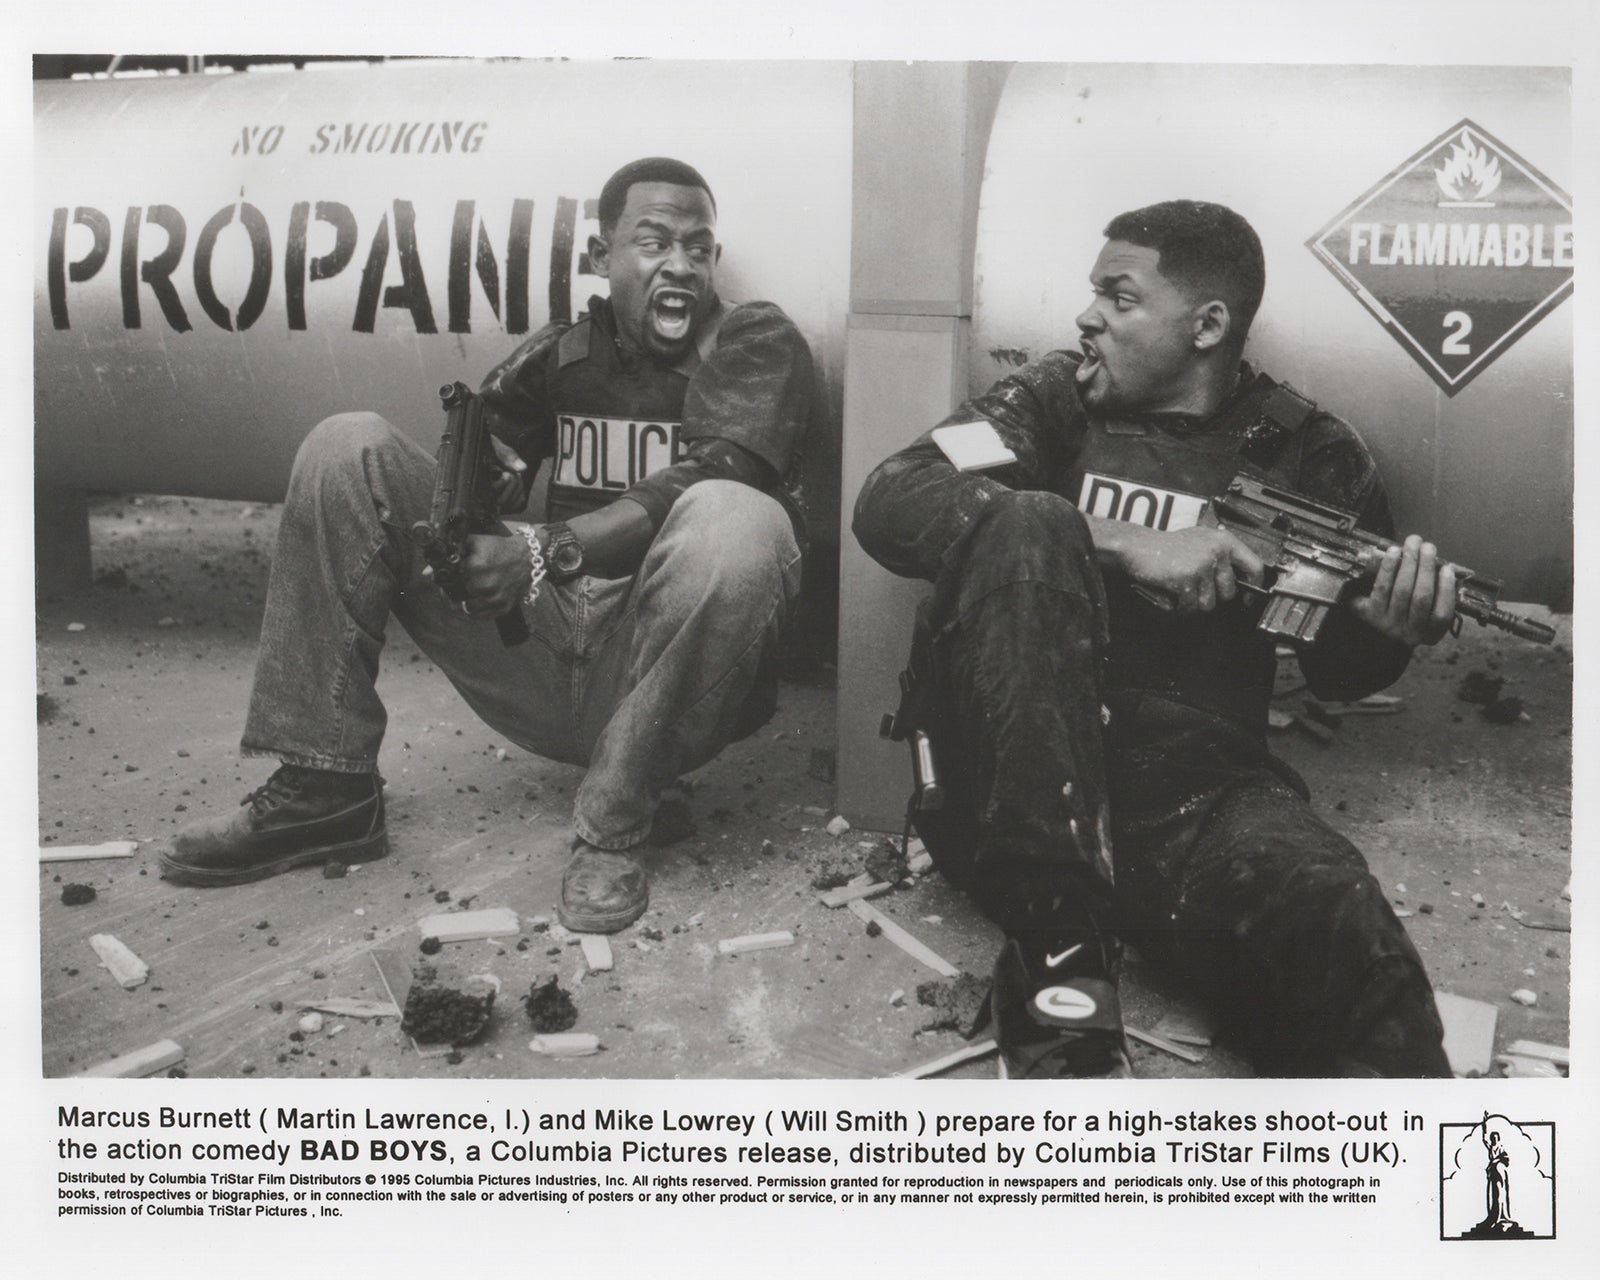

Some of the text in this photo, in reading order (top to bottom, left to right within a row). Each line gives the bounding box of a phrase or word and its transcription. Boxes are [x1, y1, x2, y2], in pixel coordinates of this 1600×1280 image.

[231, 121, 488, 156] NO SMOKING
[1349, 223, 1575, 267] FLAMMABLE
[1441, 311, 1472, 354] 2
